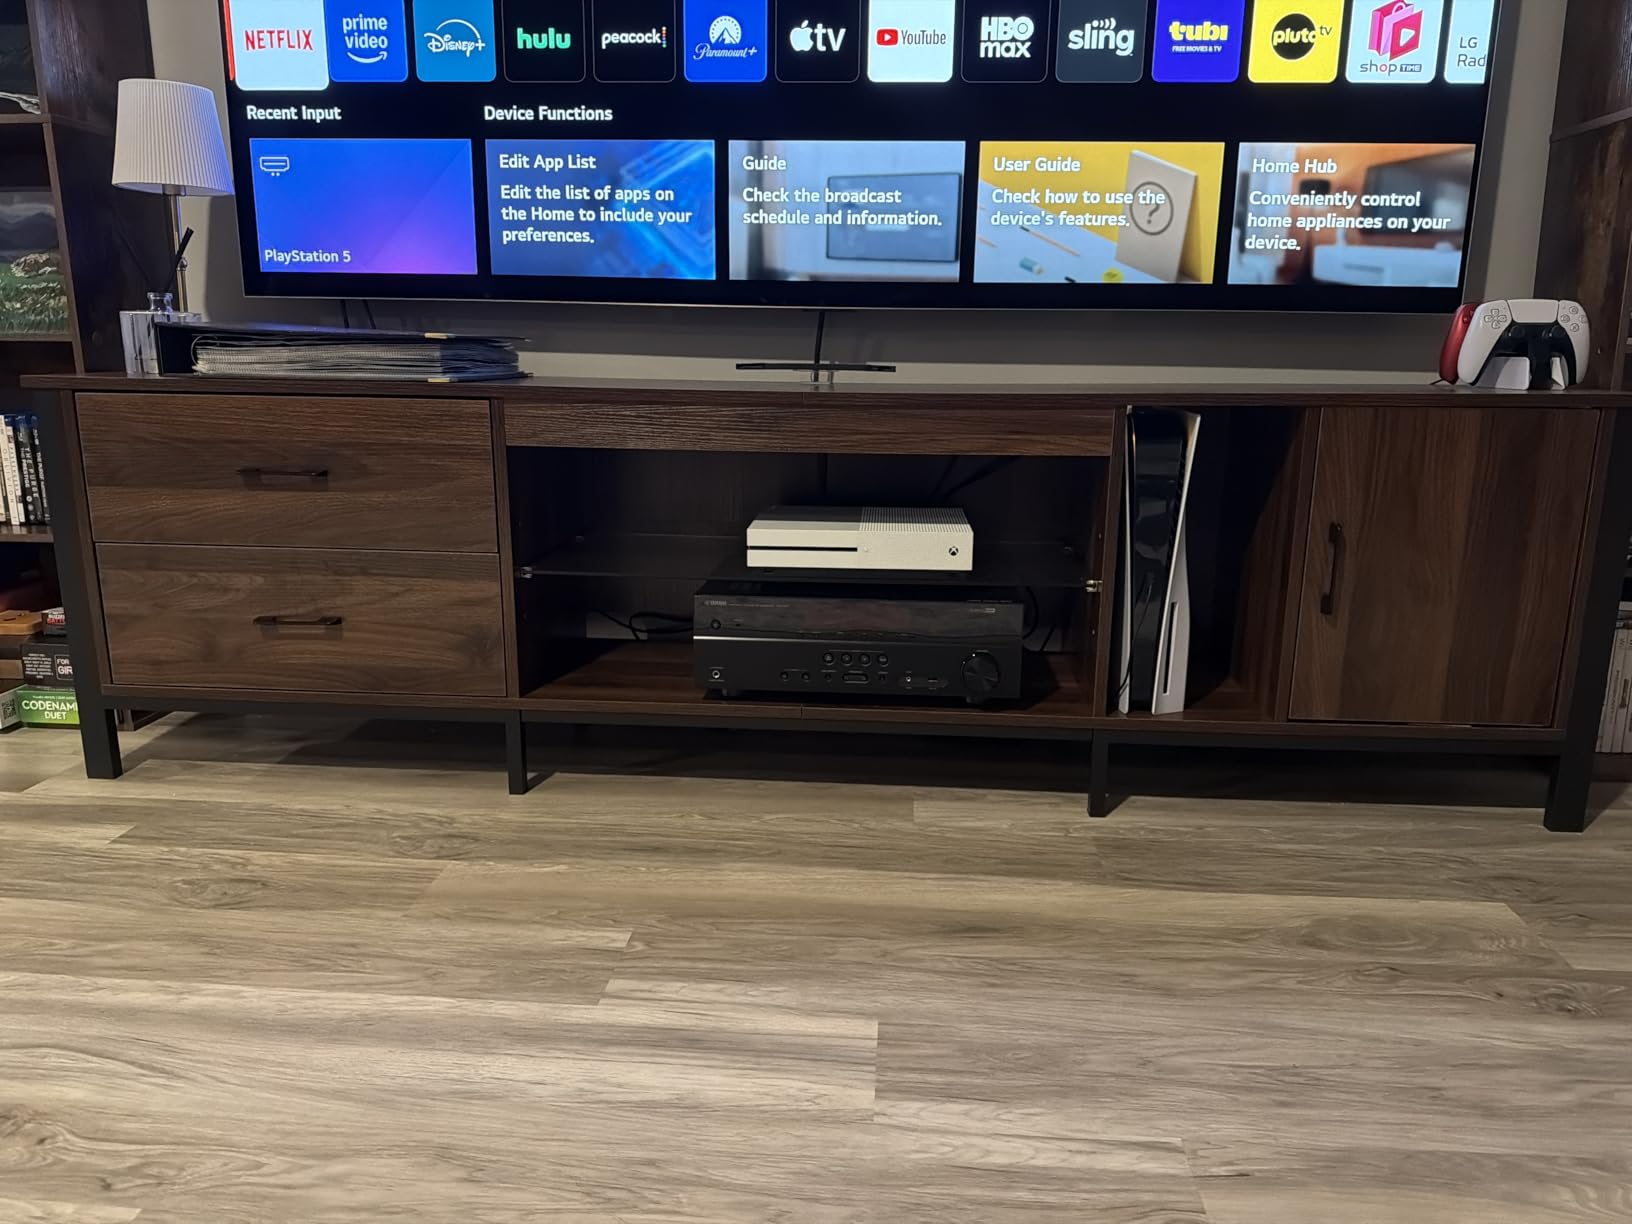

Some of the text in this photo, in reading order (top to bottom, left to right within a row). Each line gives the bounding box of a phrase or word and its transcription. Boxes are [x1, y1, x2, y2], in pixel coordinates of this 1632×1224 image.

[342, 14, 388, 34] prime
[980, 16, 1035, 41] HBO
[1169, 21, 1229, 41] tubi
[244, 29, 314, 51] NETFLIX
[345, 33, 388, 49] video
[517, 27, 571, 49] hulu
[813, 23, 846, 52] tv
[901, 29, 946, 45] YouTube
[1068, 18, 1135, 56] sling
[1273, 24, 1333, 46] pluto tv
[1459, 36, 1478, 49] LG
[693, 43, 758, 60] Paramount+
[980, 41, 1031, 58] max
[1360, 60, 1421, 76] shop TIME
[1457, 54, 1487, 68] Rad
[246, 105, 342, 124] Recent Input
[484, 106, 613, 122] Device Functions
[499, 154, 597, 173] Edit App List
[742, 156, 787, 171] Guide
[993, 157, 1081, 173] User Guide
[1252, 159, 1338, 174] Home Hub
[500, 185, 675, 206] Edit the list of apps on
[743, 188, 902, 204] Check the broadcast
[992, 189, 1166, 206] Check how to use the
[1249, 191, 1421, 209] Conveniently control
[501, 207, 693, 227] the Home to include your
[743, 211, 943, 227] schedule and information.
[990, 211, 1130, 227] device's features.
[1247, 213, 1451, 233] home appliances on your
[502, 227, 595, 246] preferences.
[1245, 235, 1301, 251] device.
[264, 249, 351, 265] PlayStation 5
[44, 711, 67, 719] DUET
